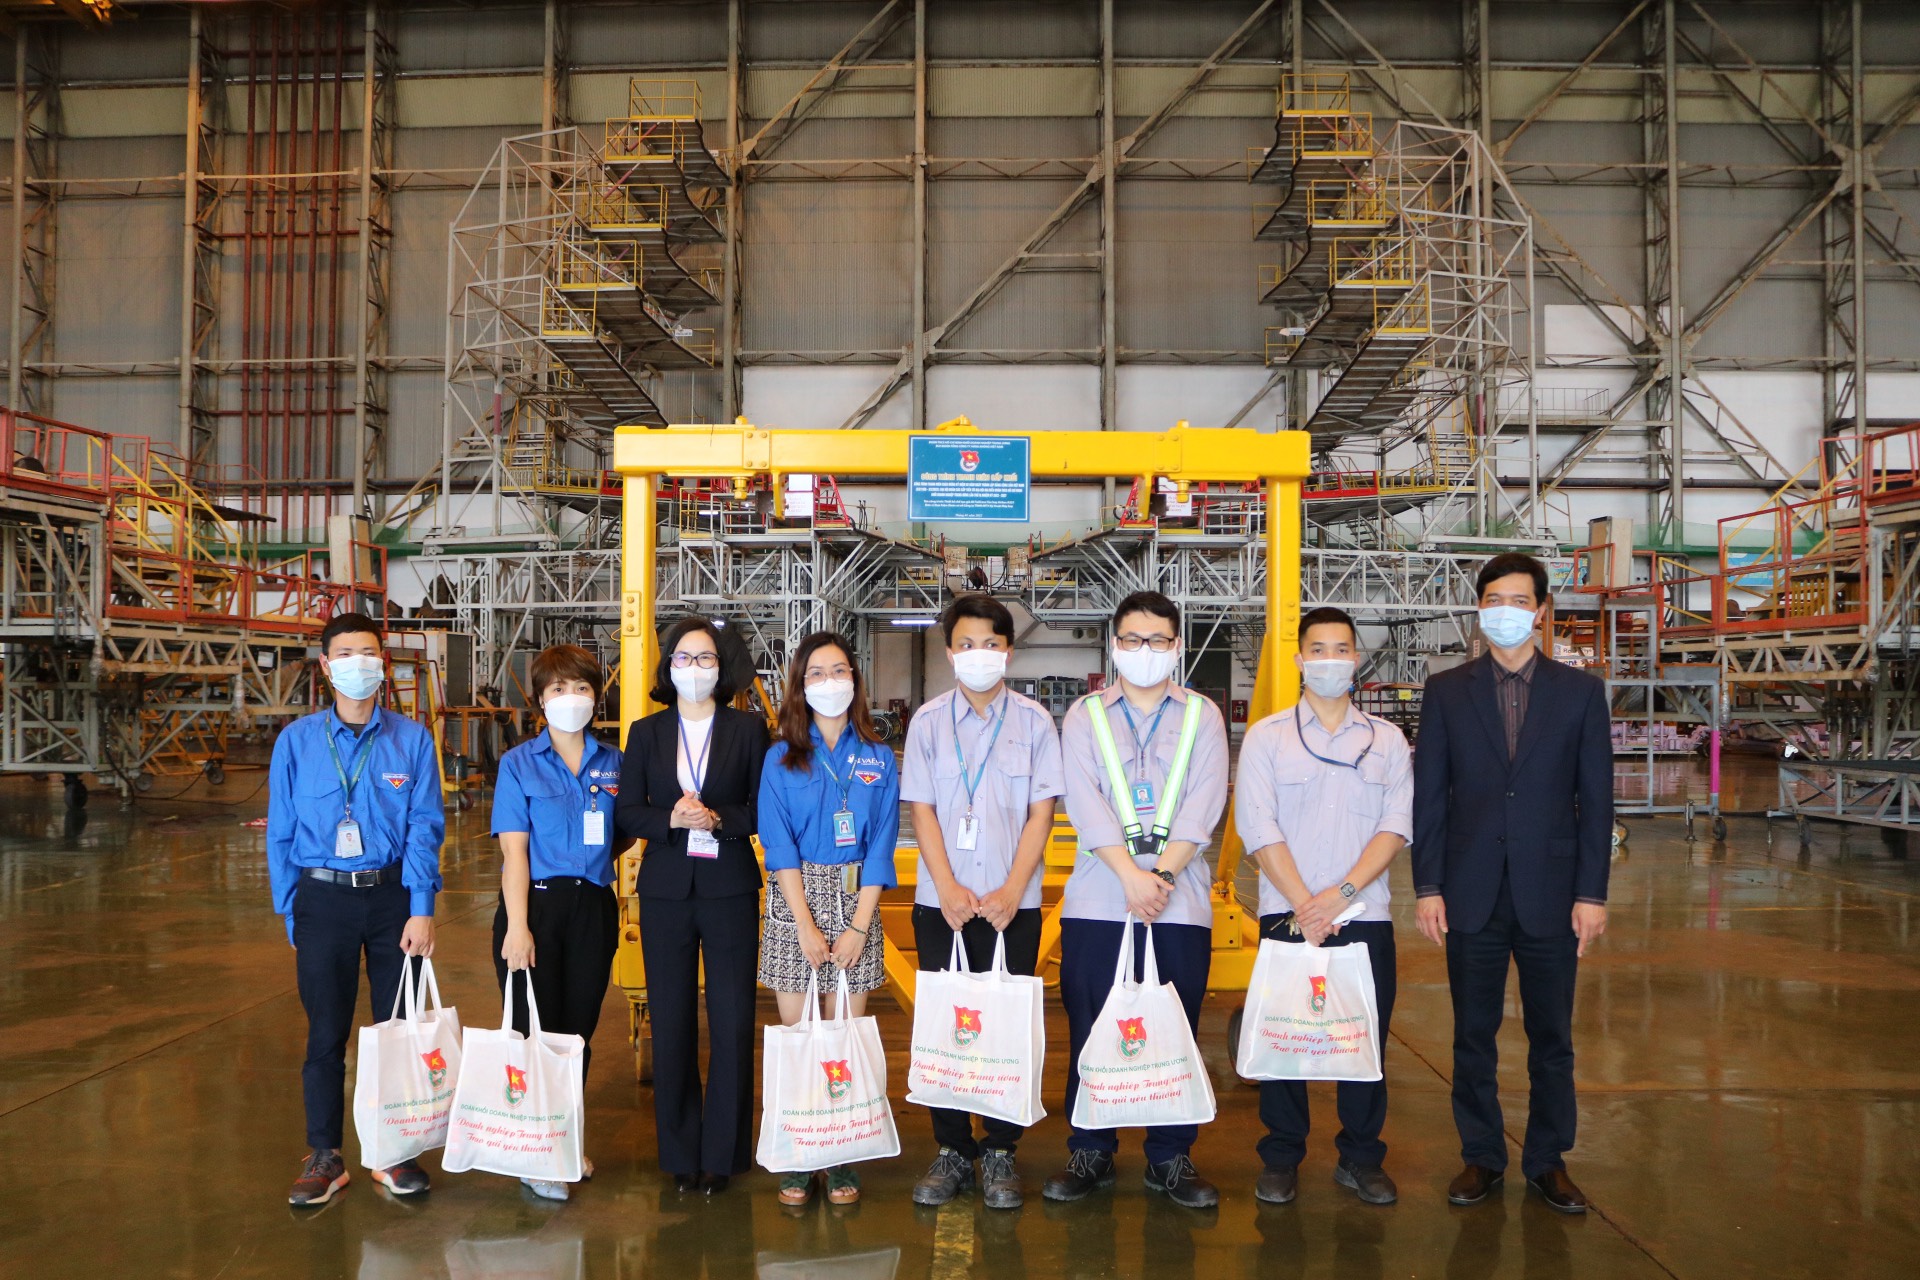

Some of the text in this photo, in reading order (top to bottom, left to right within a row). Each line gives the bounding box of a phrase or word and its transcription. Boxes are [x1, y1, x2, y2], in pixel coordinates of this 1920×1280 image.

[1260, 1028, 1288, 1040] Doanh
[1271, 1043, 1289, 1052] Trao
[1151, 1060, 1170, 1068] TRUNG
[920, 1075, 936, 1085] Trao
[968, 1072, 994, 1082] Trung
[1090, 1094, 1108, 1103] Trao
[489, 1110, 509, 1118] DOANH
[384, 1115, 417, 1125] Doanh
[457, 1118, 484, 1129] Doanh
[517, 1130, 542, 1140] Trung
[782, 1123, 813, 1133] Doanh
[850, 1120, 872, 1128] Trung
[400, 1128, 421, 1136] Trao
[467, 1133, 483, 1143] Trao
[794, 1138, 816, 1146] Trao
